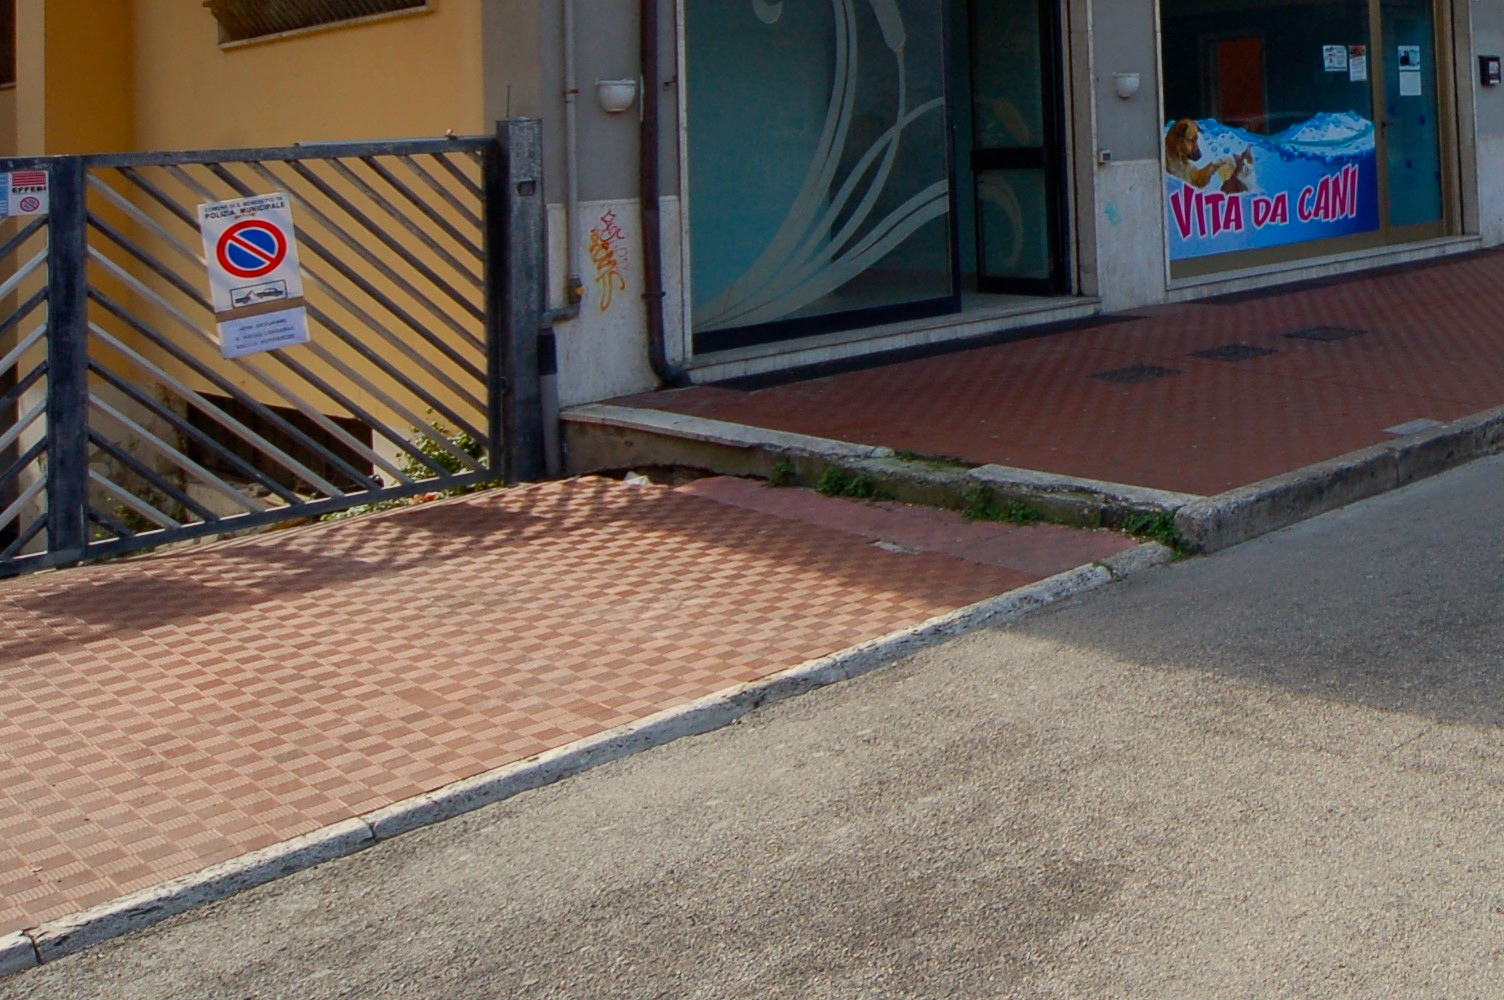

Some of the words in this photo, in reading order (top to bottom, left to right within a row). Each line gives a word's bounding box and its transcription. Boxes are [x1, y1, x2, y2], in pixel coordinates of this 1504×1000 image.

[204, 209, 236, 220] POLIZIA
[240, 201, 285, 214] MUNICIPALE
[1170, 183, 1244, 240] VITA
[1252, 192, 1289, 229] DA
[1297, 163, 1359, 222] CANI
